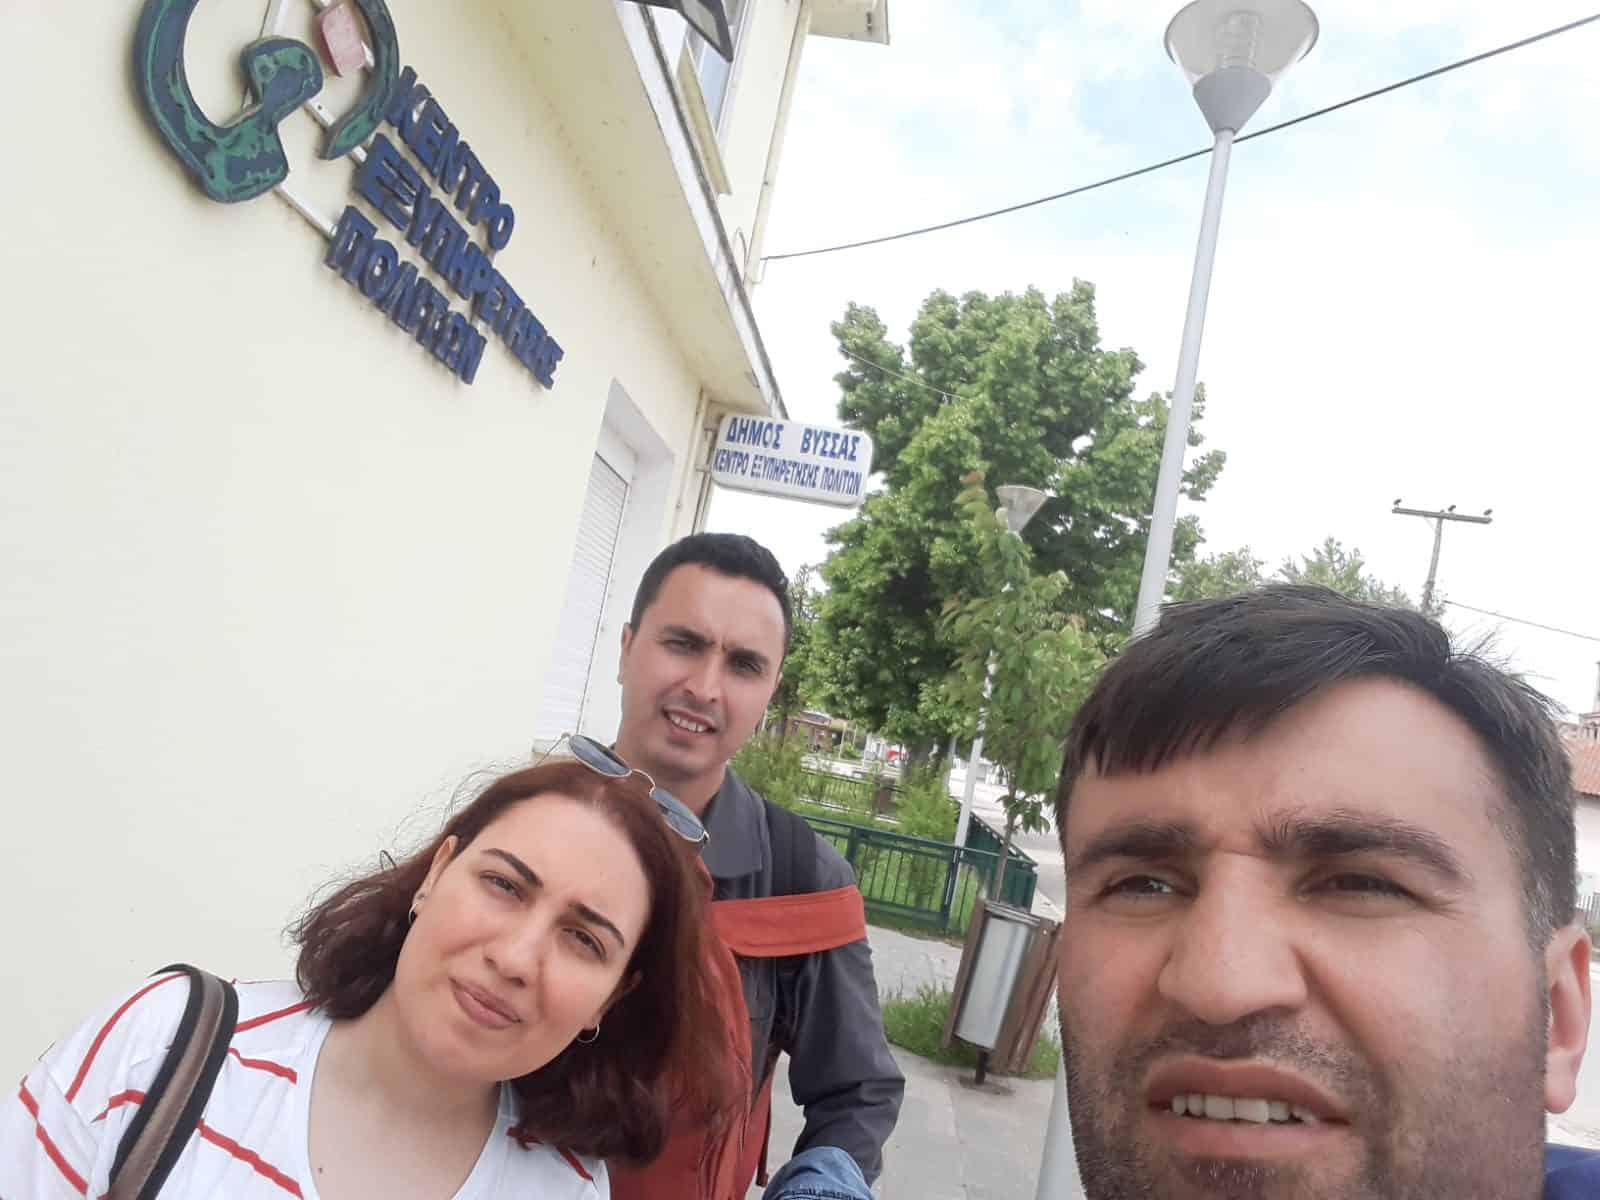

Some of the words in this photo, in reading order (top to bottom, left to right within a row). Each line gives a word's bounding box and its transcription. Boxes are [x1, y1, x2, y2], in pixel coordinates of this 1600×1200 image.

[385, 65, 515, 251] ΚΕΝΤΡΟ
[324, 204, 488, 385] ΠΟΛΙΤΩΝ
[713, 448, 750, 476] ΚΕΝΤΡΟ
[751, 454, 820, 489] ΕΞΥΠΗΡΕΤΗΣΗΣ
[820, 466, 863, 497] ΠΟΛΙΤΩΝ
[726, 416, 784, 450] ΔΗΜΟΣ
[800, 428, 860, 462] ΒΥΣΣΑΣ
